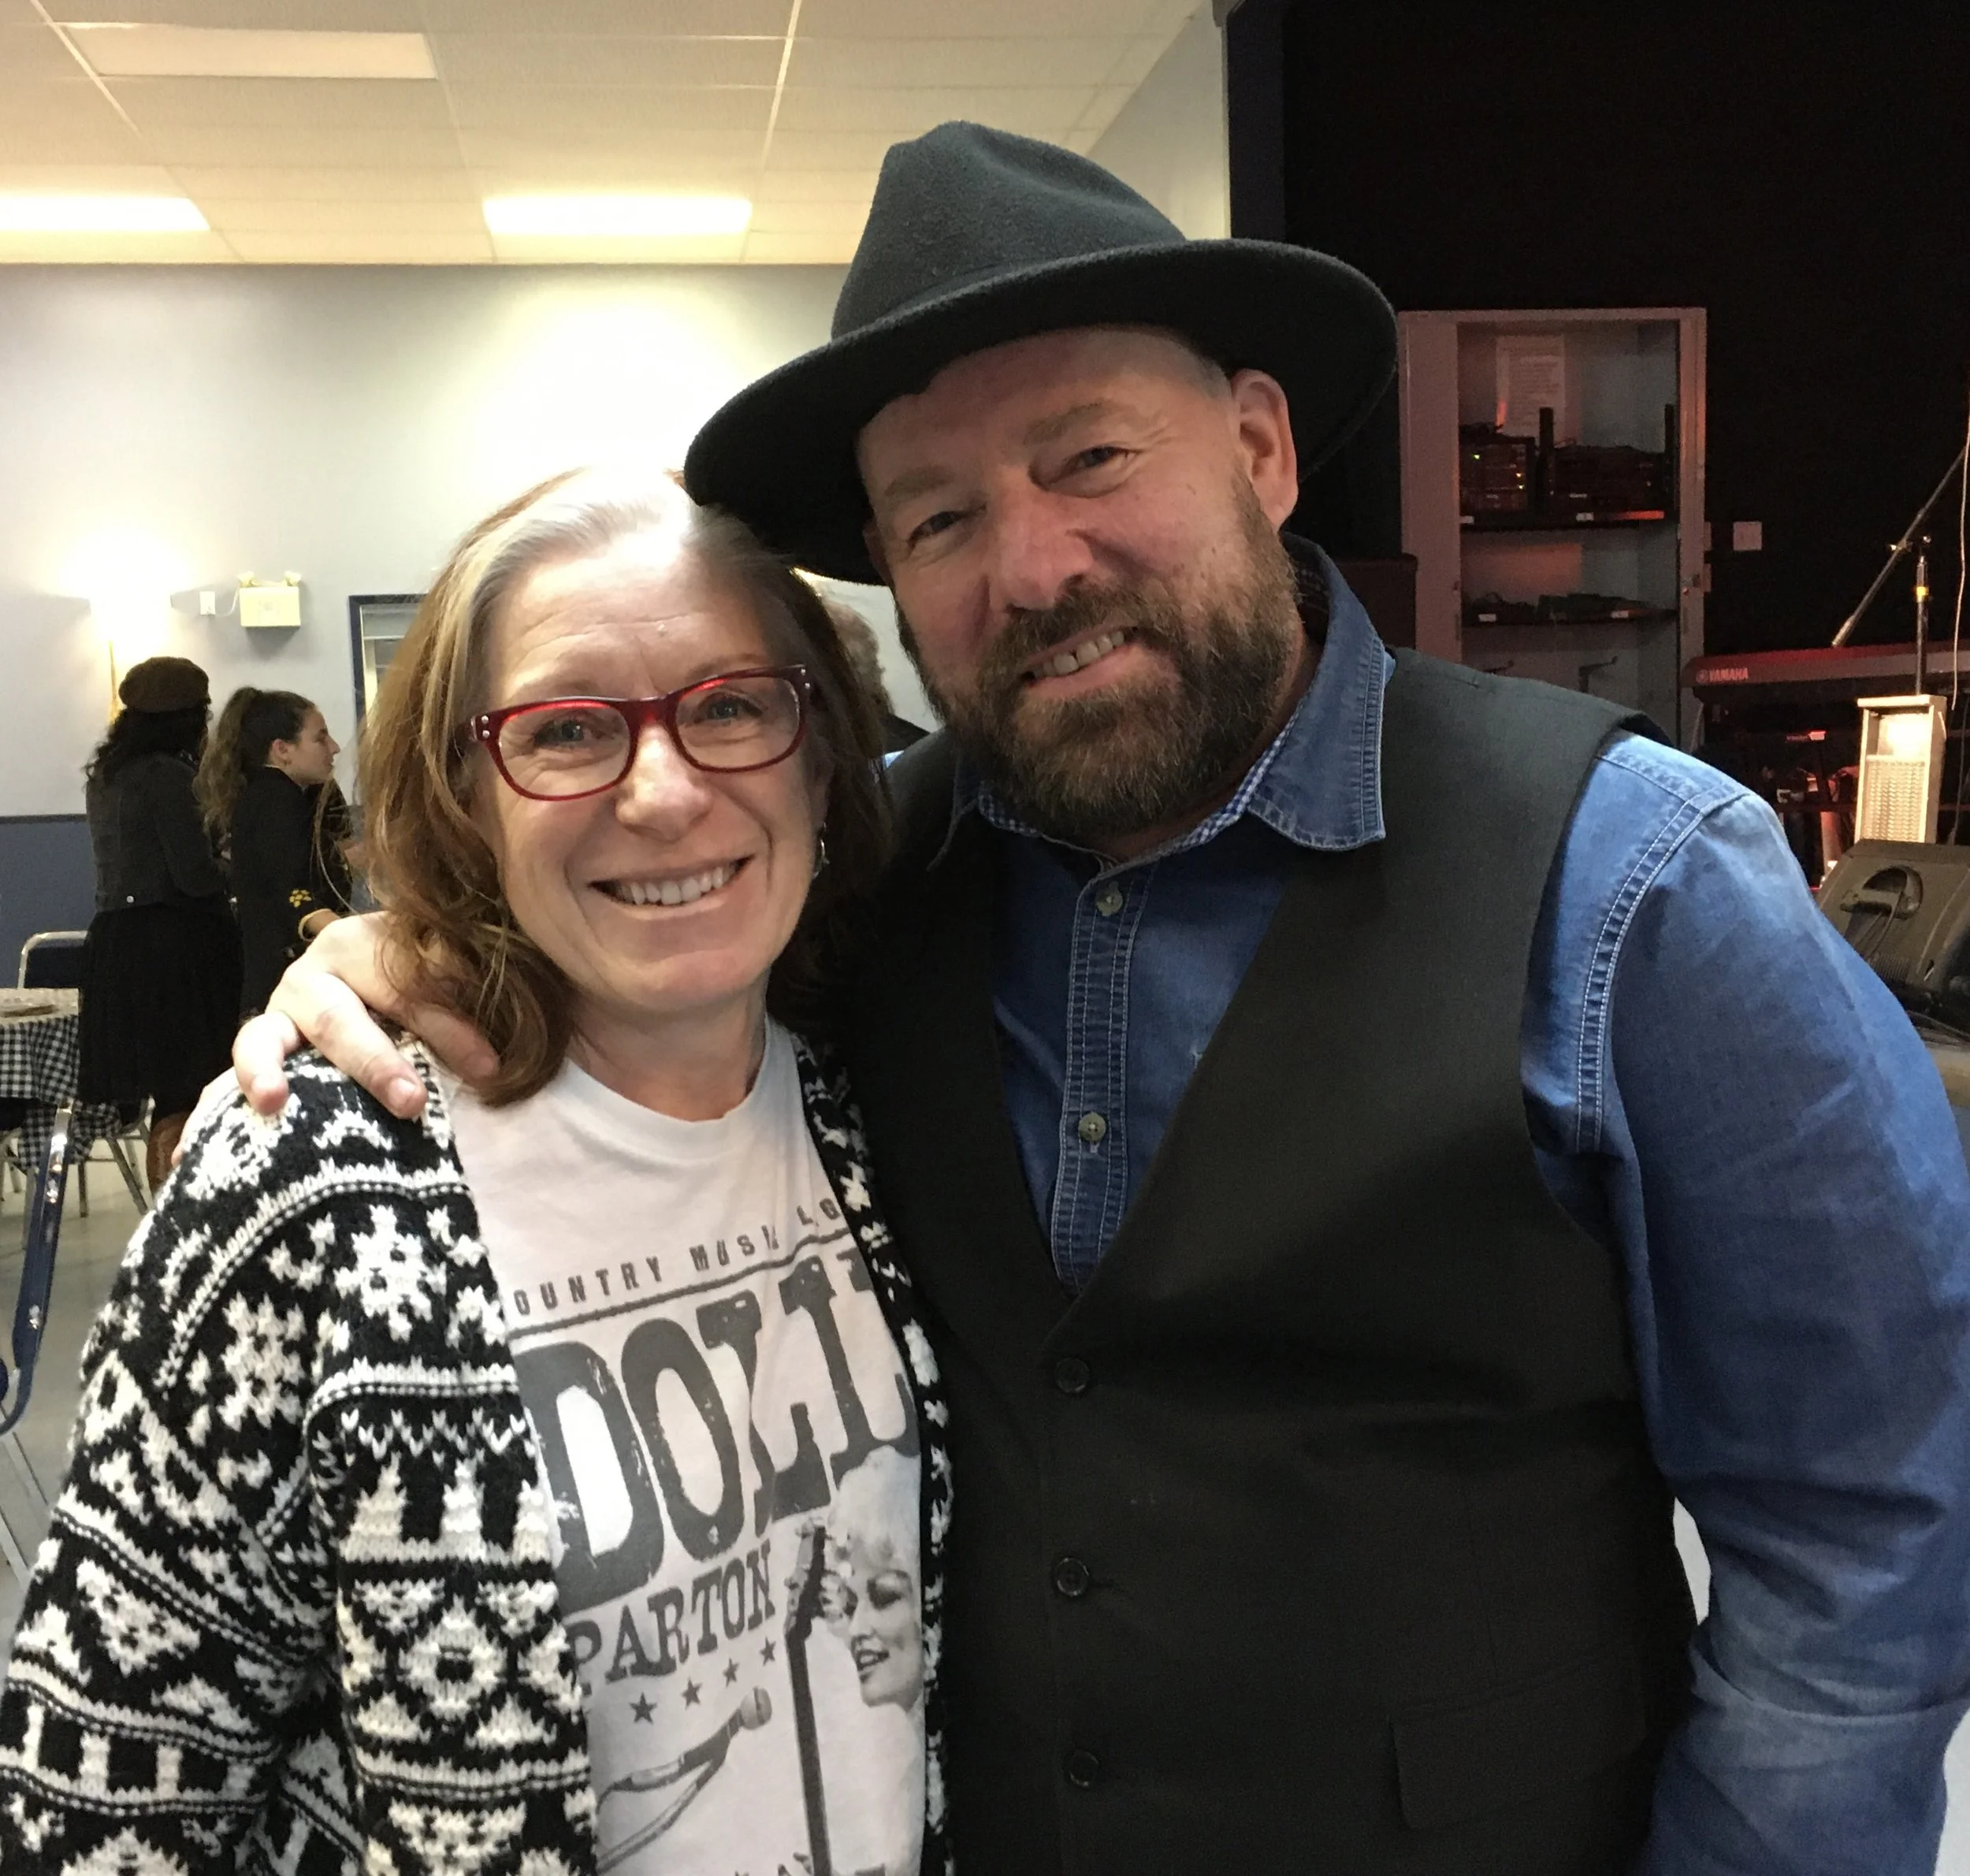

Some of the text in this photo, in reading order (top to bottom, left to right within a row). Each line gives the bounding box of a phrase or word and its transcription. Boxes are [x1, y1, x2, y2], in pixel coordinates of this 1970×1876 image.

[1708, 667, 1749, 682] YAMAHA
[513, 1255, 662, 1316] OUNTRY
[690, 1224, 780, 1272] MUSI
[564, 1539, 776, 1696] PARTON
